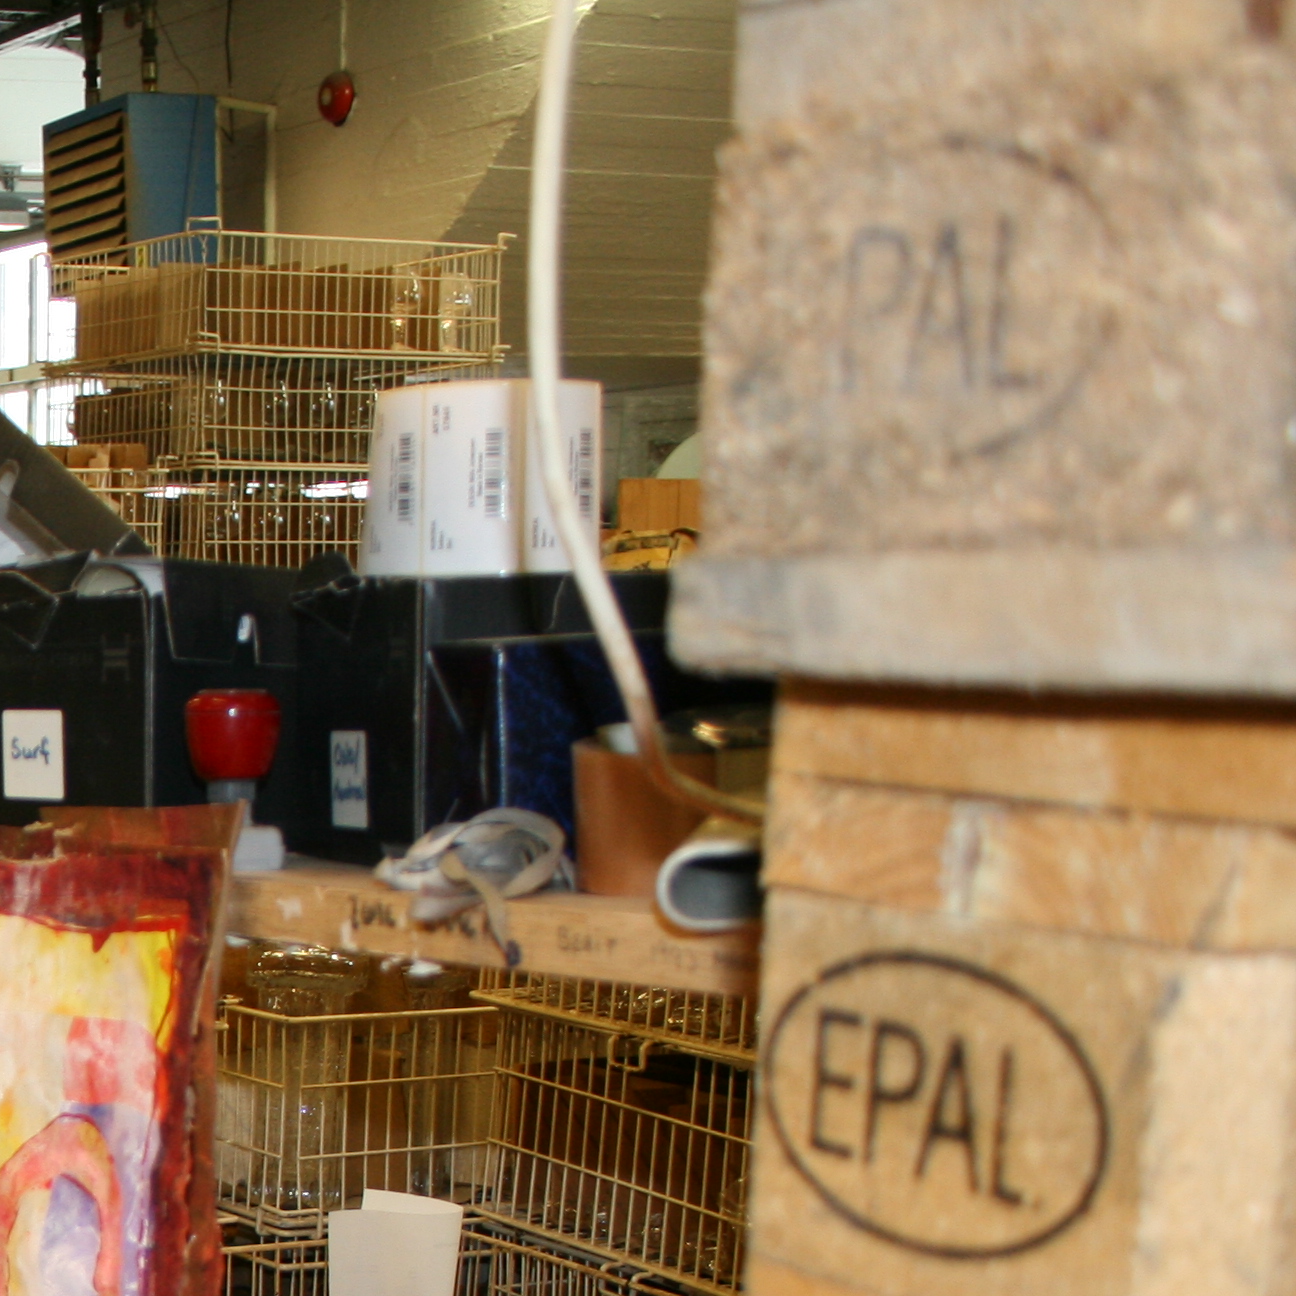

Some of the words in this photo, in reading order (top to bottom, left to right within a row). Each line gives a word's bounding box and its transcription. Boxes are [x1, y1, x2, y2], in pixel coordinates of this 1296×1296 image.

[838, 211, 1044, 394] PAL
[11, 736, 51, 765] Surf
[807, 1005, 1022, 1206] EPAL
